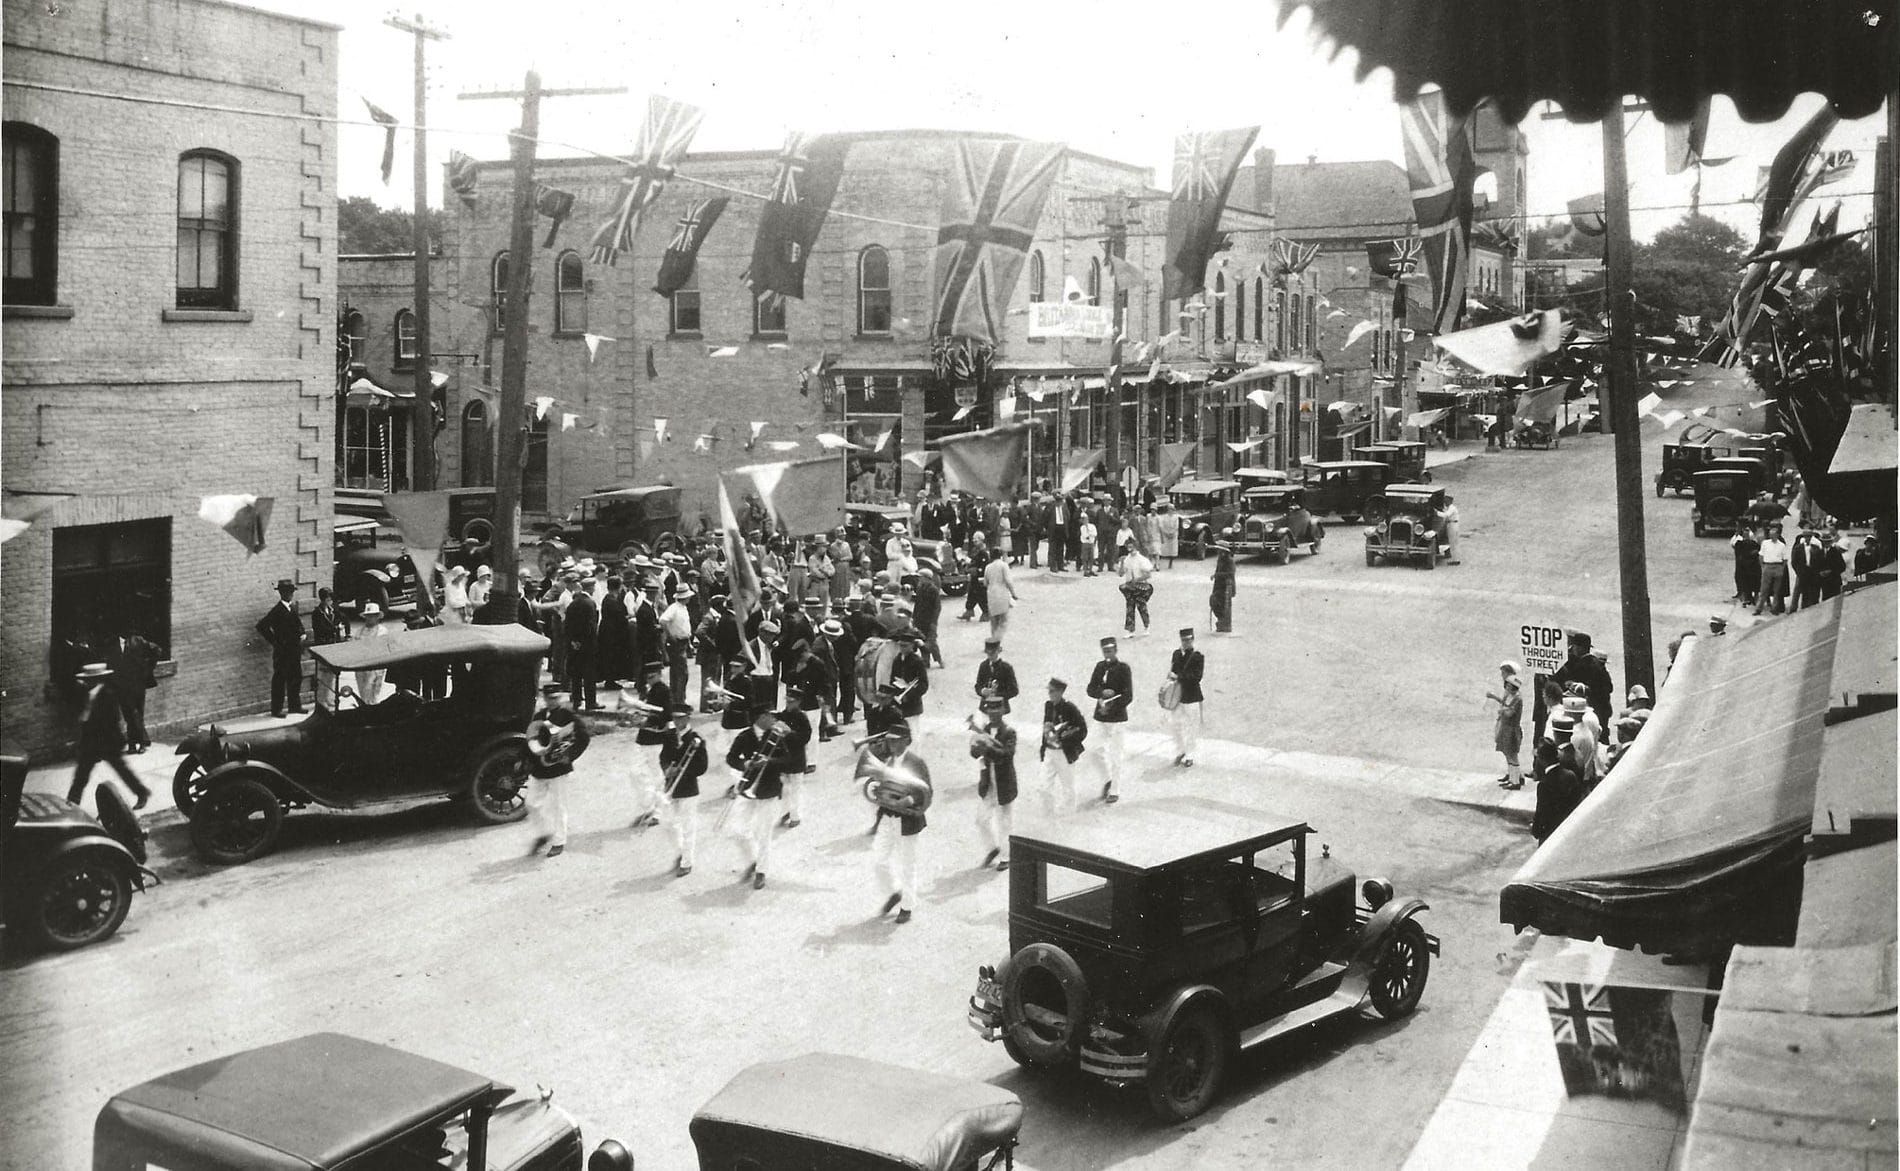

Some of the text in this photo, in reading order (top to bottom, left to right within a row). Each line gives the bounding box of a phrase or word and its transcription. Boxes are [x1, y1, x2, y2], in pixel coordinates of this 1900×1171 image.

[1521, 626, 1562, 648] STOP
[1522, 646, 1563, 660] THROUGH
[1526, 658, 1559, 670] STREET
